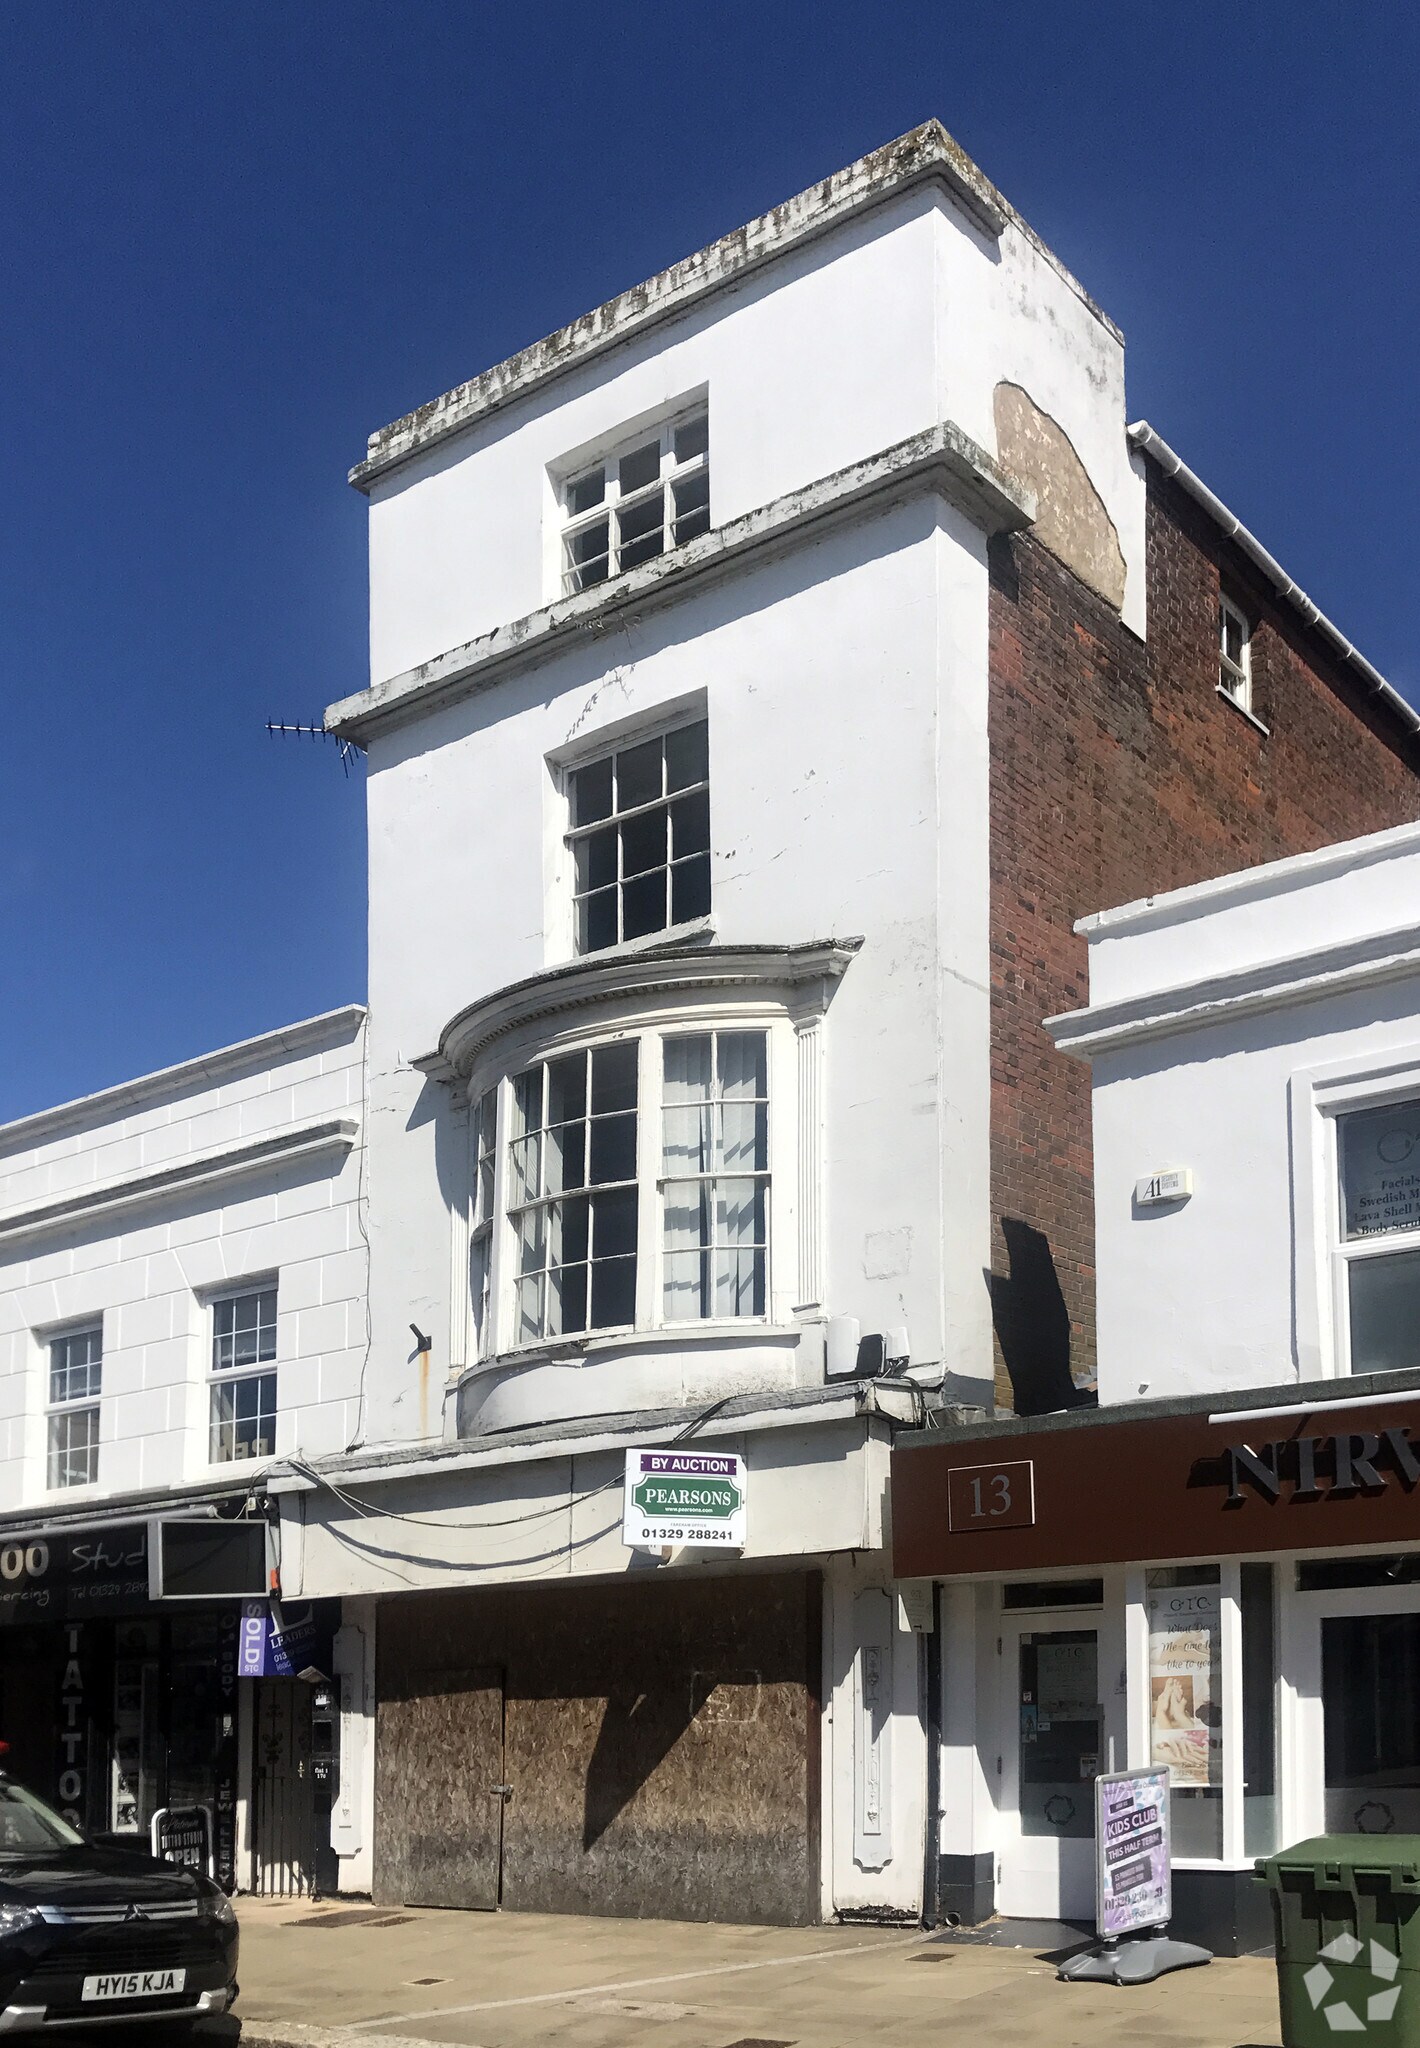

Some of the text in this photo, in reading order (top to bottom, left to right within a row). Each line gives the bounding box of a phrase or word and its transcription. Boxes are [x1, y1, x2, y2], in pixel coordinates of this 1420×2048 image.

[1143, 1177, 1161, 1199] A1
[1359, 1190, 1406, 1208] Swedish
[1354, 1211, 1380, 1223] Lava
[1383, 1202, 1412, 1217] Shell
[1362, 1223, 1388, 1240] Body
[651, 1457, 729, 1472] BY AUCTION
[645, 1488, 731, 1506] PEARSONS
[970, 1473, 1012, 1518] 13
[665, 1506, 713, 1514] www.pearsons.com
[642, 1528, 733, 1540] 01329 288241
[245, 1604, 262, 1664] SOLD
[270, 1624, 317, 1649] LEADERS
[244, 1665, 260, 1674] STC
[1166, 1658, 1183, 1670] like
[1185, 1658, 1195, 1669] to
[218, 1778, 233, 1884] JEWELLERY
[1108, 1809, 1157, 1839] KIDS CLUB
[164, 1847, 200, 1866] OPEN
[1108, 1834, 1160, 1860] THIS HALF TERM
[96, 1972, 175, 1996] HY15 KJA
